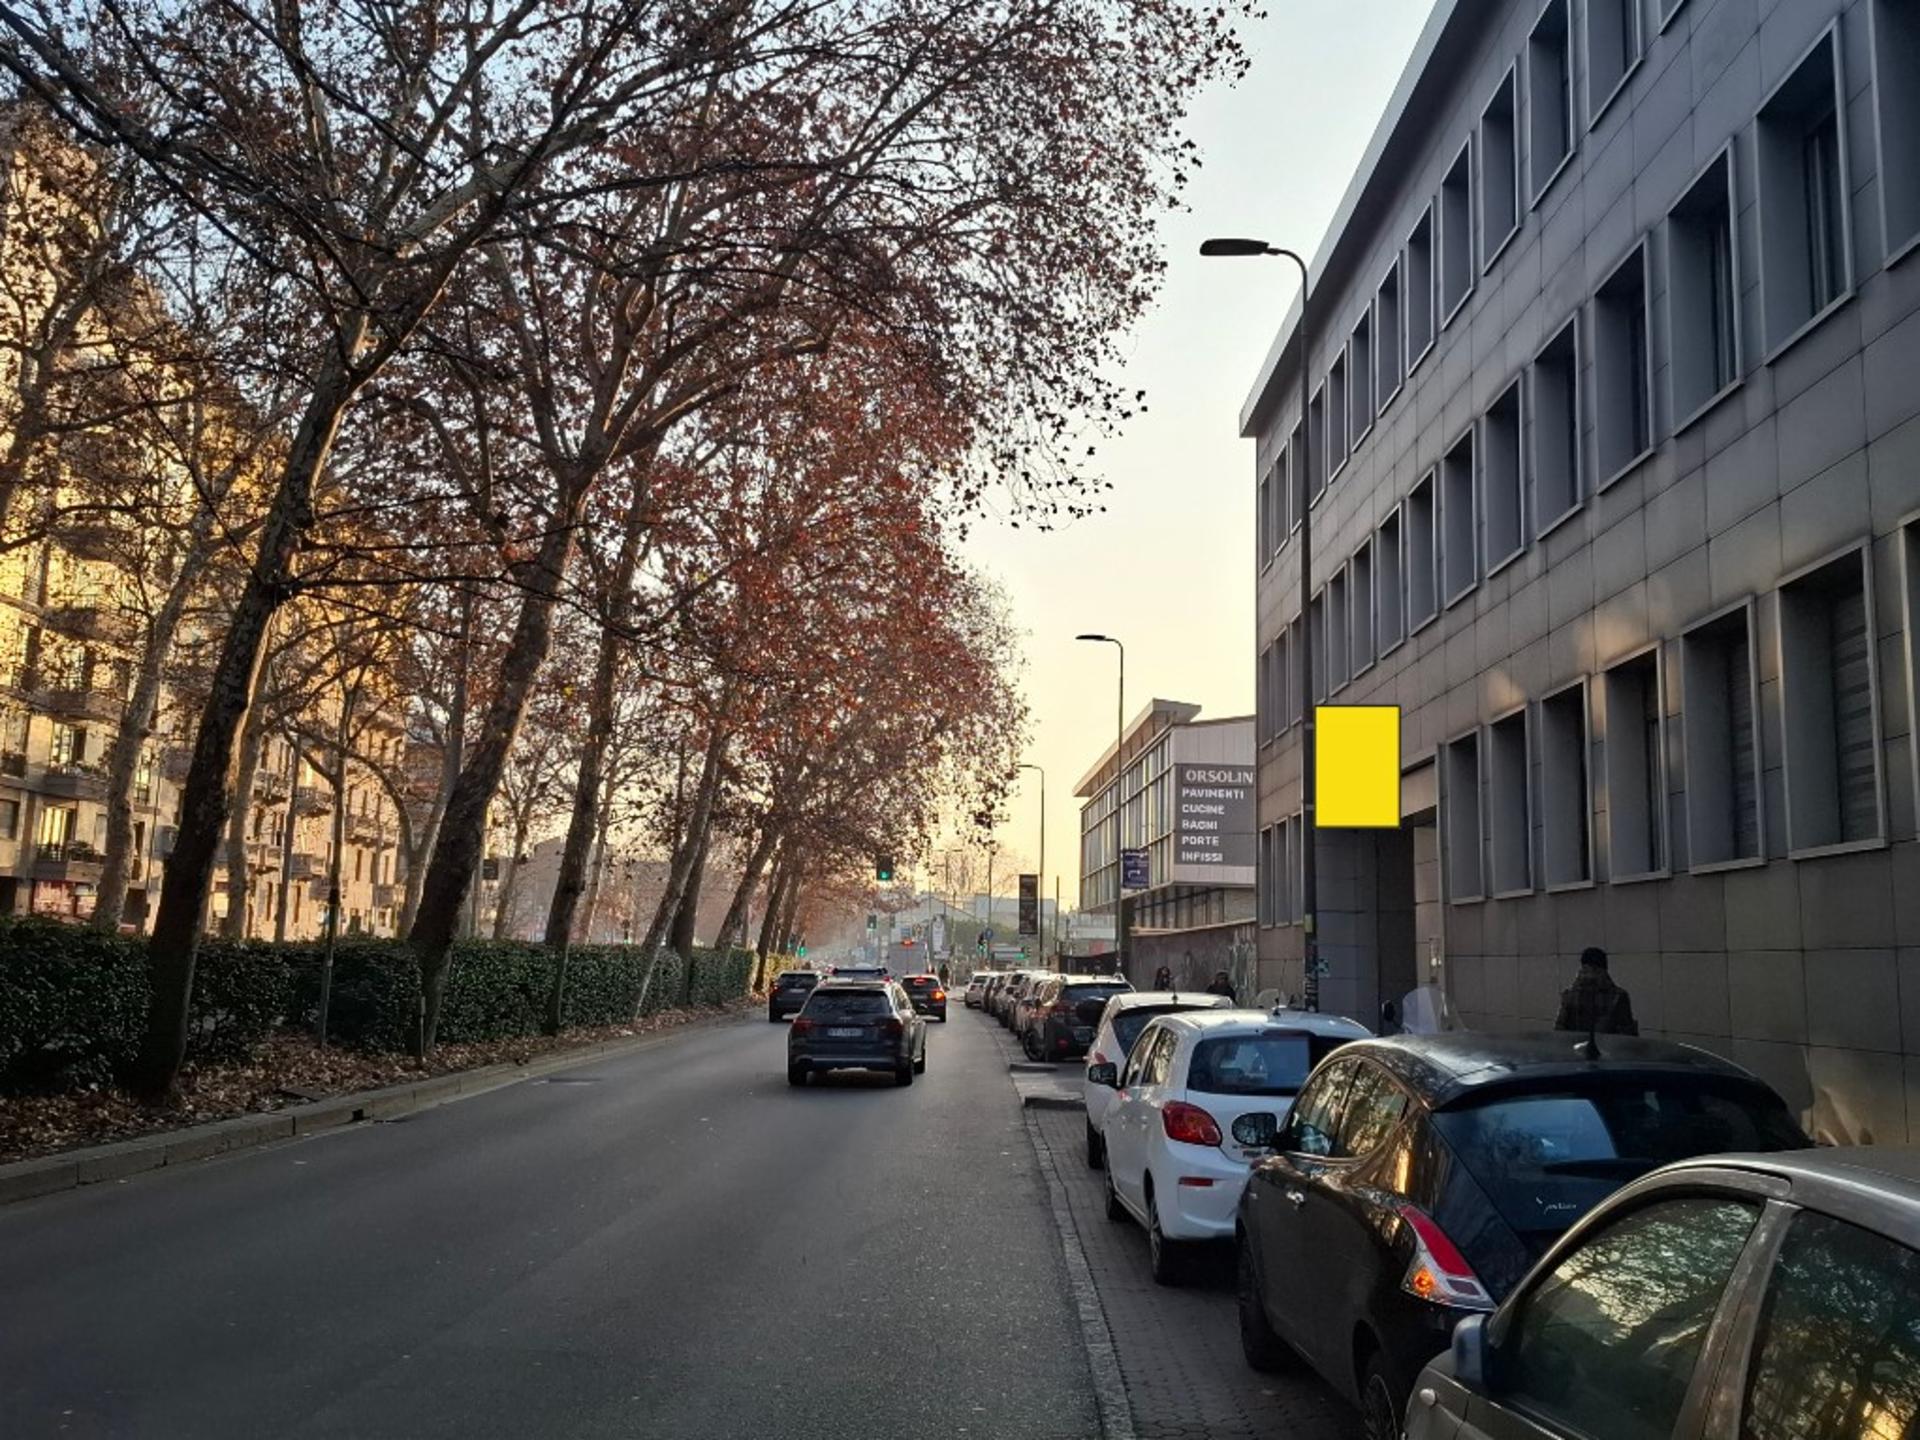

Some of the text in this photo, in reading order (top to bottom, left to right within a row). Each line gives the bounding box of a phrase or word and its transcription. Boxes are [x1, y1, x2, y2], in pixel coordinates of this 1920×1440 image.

[1182, 804, 1225, 815] CUCINE
[1182, 819, 1218, 830] BAGNI
[1182, 836, 1220, 847] PORTE
[1182, 851, 1223, 862] INFISSI
